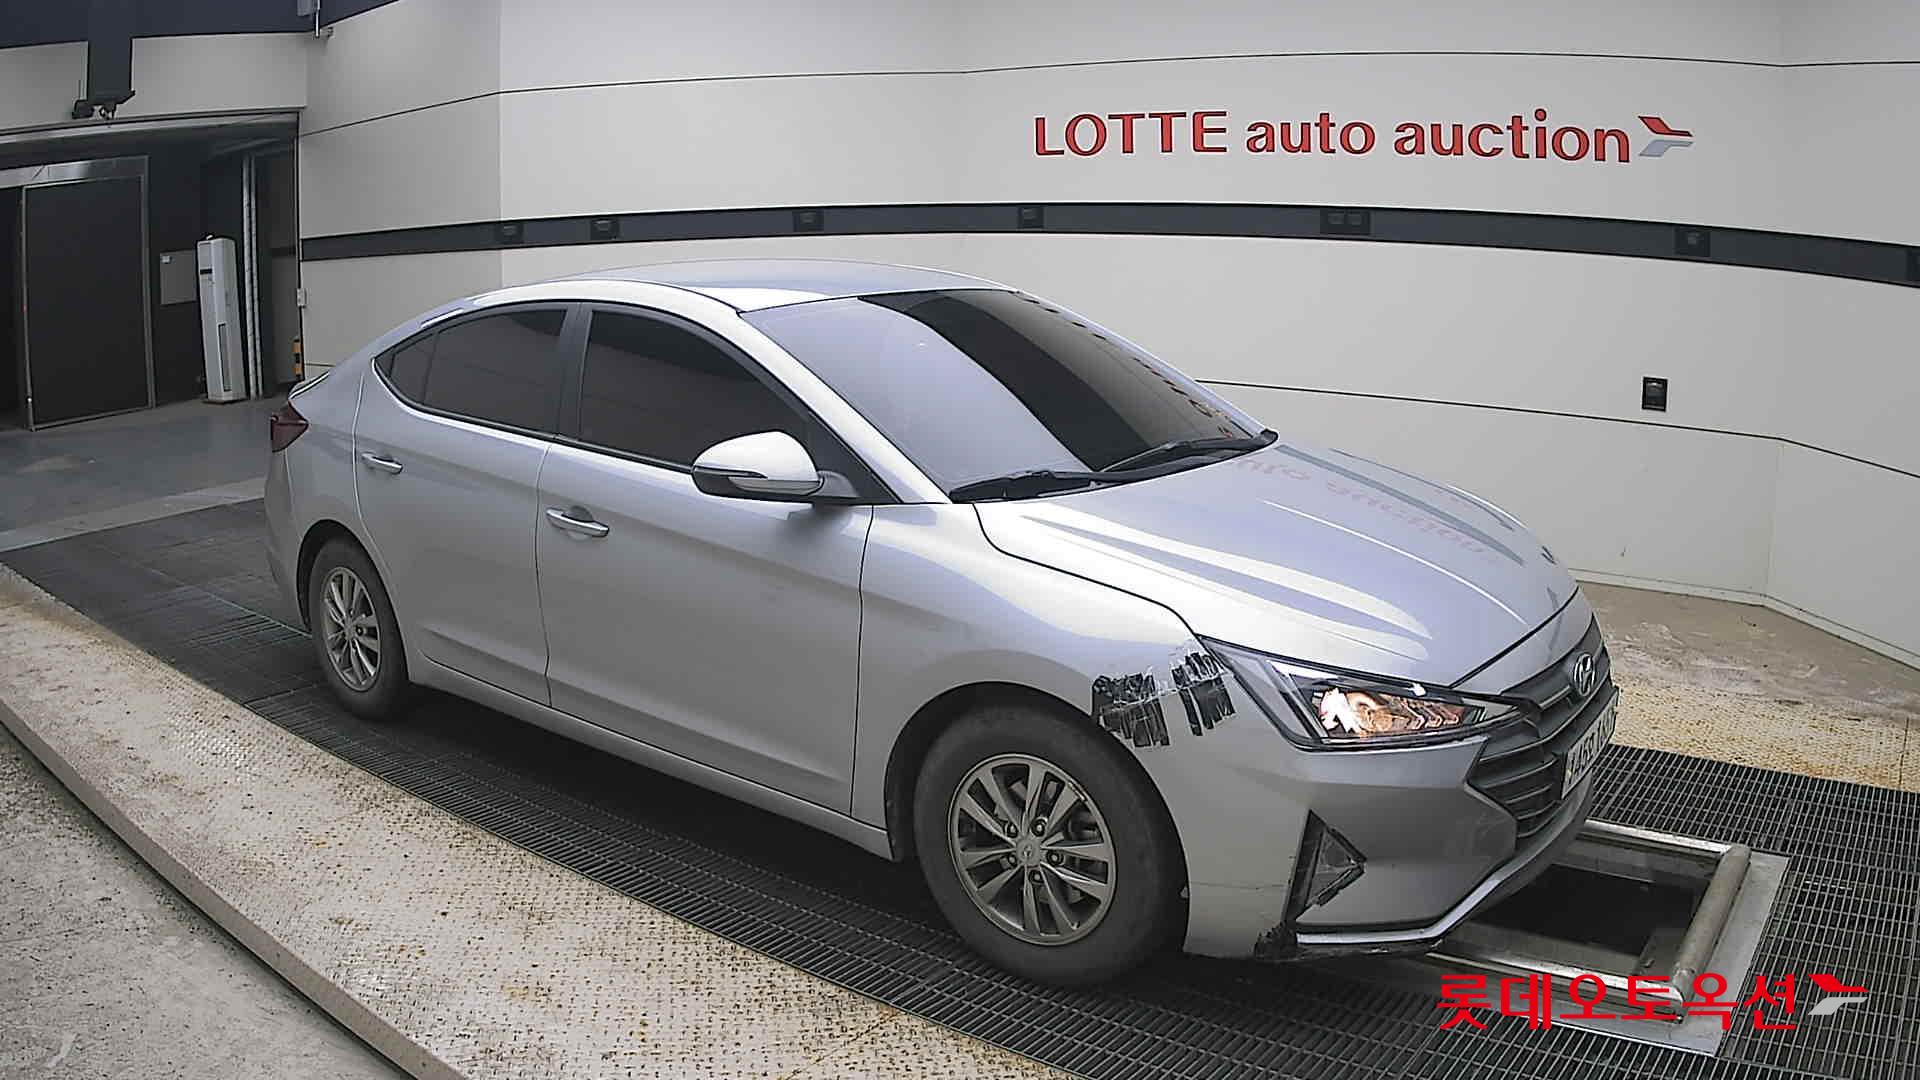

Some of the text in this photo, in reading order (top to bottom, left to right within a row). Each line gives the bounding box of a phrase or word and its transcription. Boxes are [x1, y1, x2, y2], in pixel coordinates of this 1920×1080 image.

[1034, 108, 1631, 163] LOTTE auto auction
